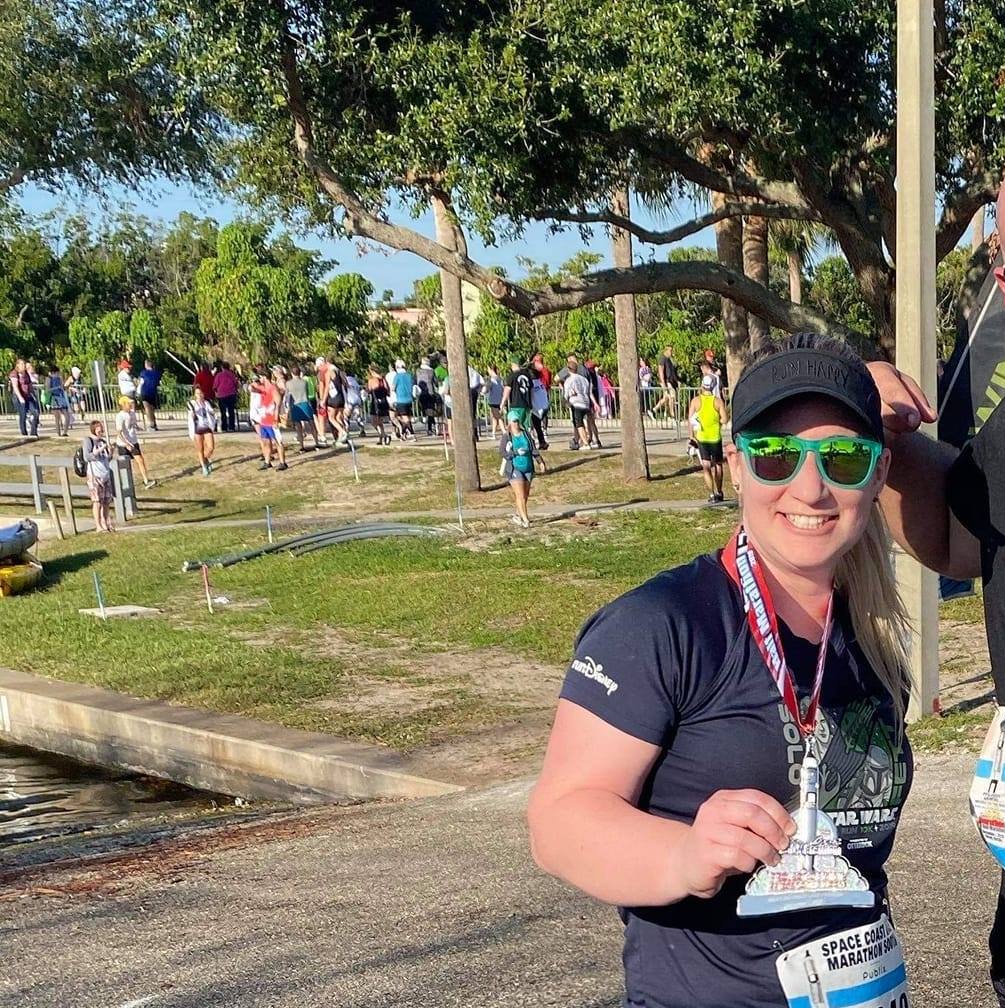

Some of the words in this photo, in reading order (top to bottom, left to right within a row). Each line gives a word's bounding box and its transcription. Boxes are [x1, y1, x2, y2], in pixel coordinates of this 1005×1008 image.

[736, 553, 771, 637] Marathon
[860, 807, 899, 824] WARS
[821, 934, 863, 957] SPACE
[864, 924, 887, 946] COAST
[827, 942, 883, 971] MARATHON
